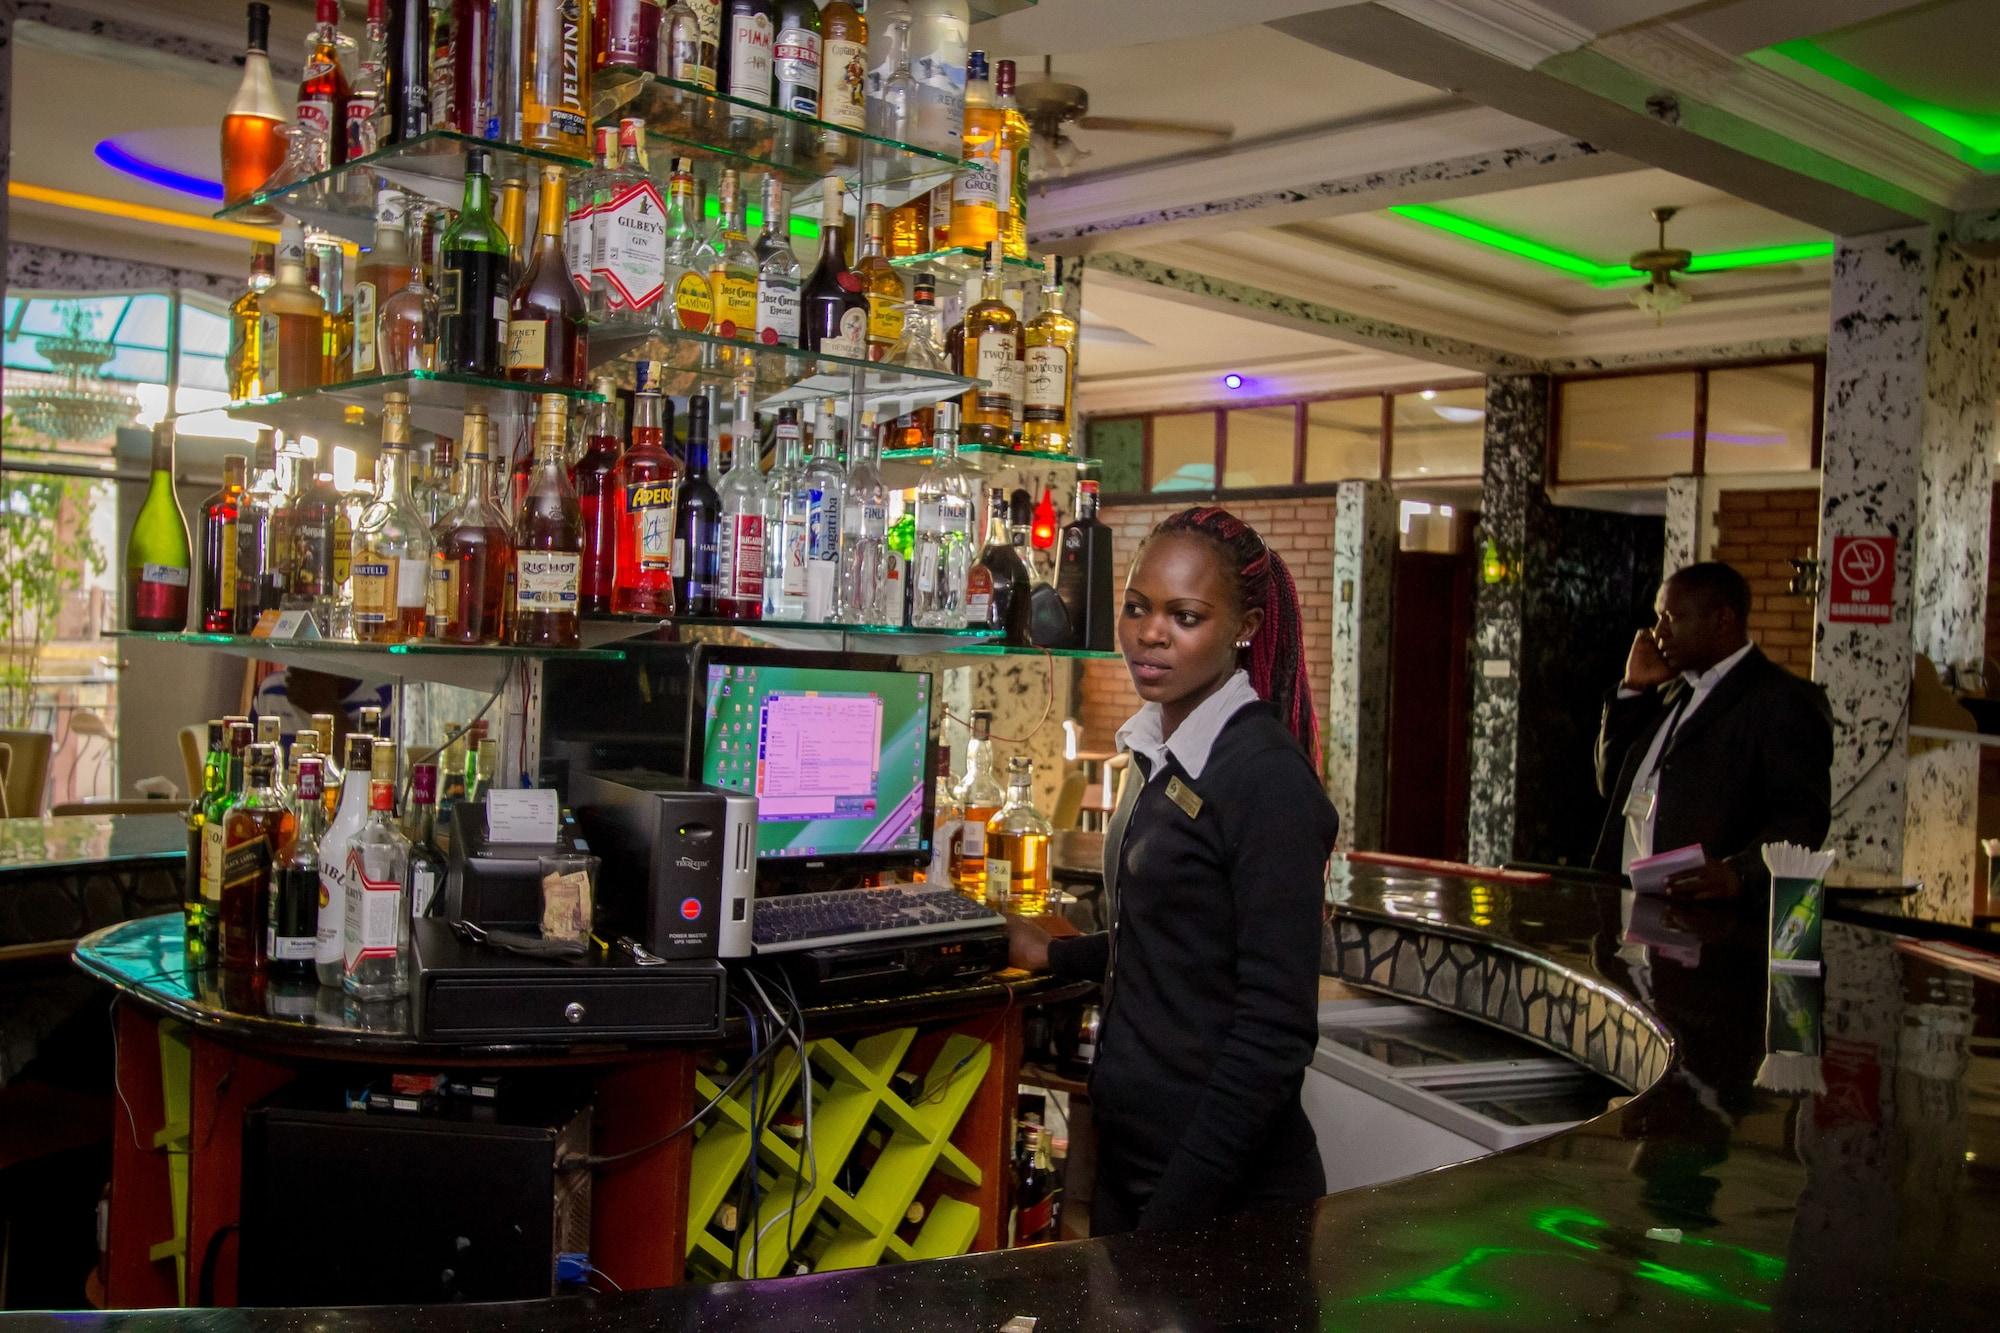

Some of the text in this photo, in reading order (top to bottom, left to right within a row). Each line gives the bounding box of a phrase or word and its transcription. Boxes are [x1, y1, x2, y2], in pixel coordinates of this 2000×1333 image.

[777, 46, 818, 62] PERN
[563, 23, 581, 111] JELZIN
[965, 179, 998, 192] GROUS
[618, 216, 664, 235] GILBEY'S
[632, 236, 648, 246] GIN
[510, 329, 536, 337] HENET
[1040, 364, 1064, 374] KEYS
[632, 487, 674, 508] APERO
[864, 507, 886, 519] FINLA
[938, 505, 967, 518] FINLAN
[522, 561, 577, 576] RICHOT
[1851, 589, 1870, 602] NO
[1831, 603, 1889, 617] SMOKING
